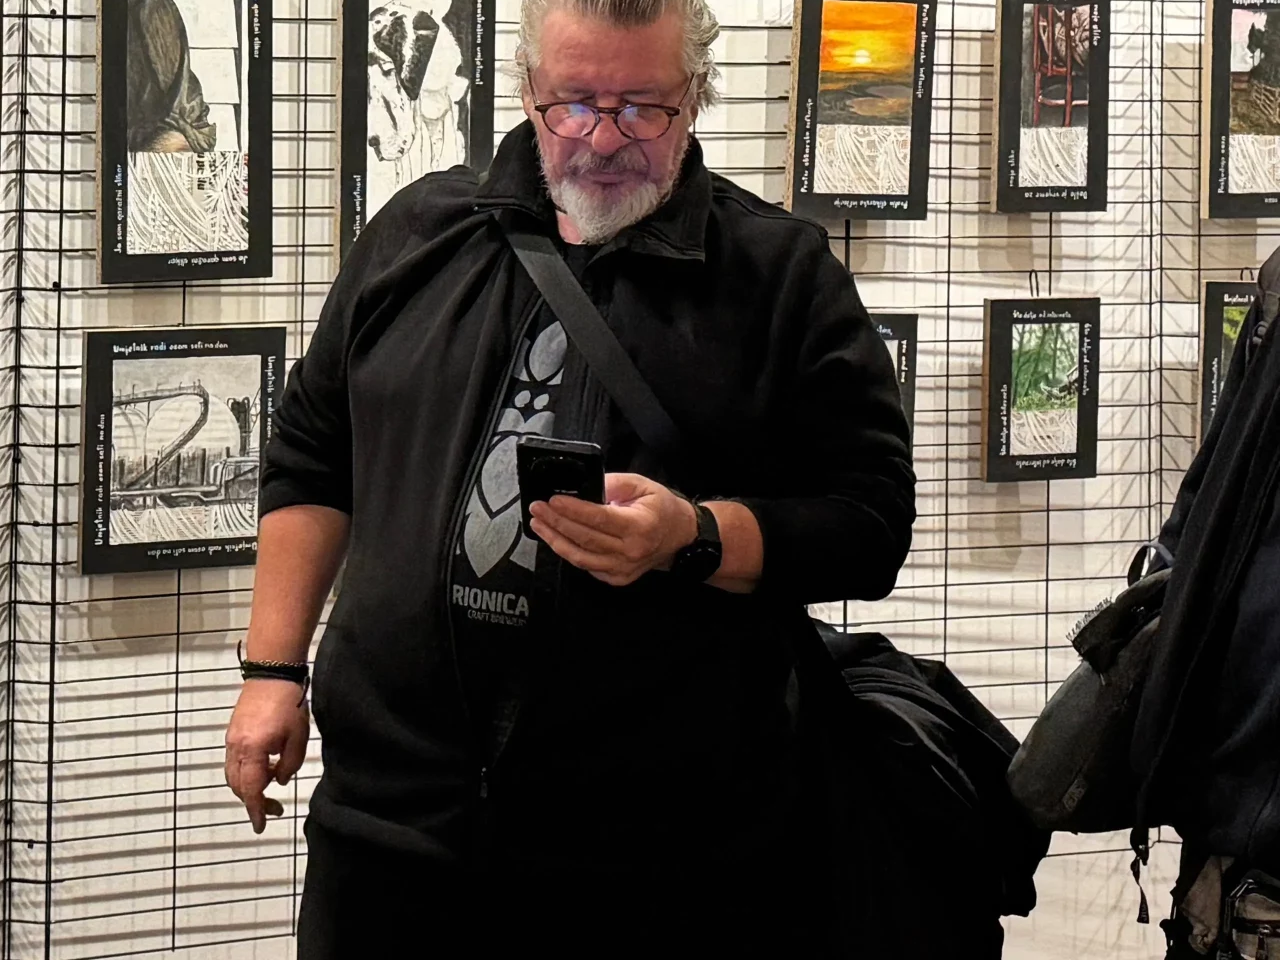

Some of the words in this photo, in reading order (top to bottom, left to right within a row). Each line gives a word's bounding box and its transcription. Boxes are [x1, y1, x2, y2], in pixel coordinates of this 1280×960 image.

[150, 341, 167, 351] radi
[214, 340, 229, 349] dan
[452, 584, 529, 617] RIONICA
[467, 609, 490, 622] CRAFT
